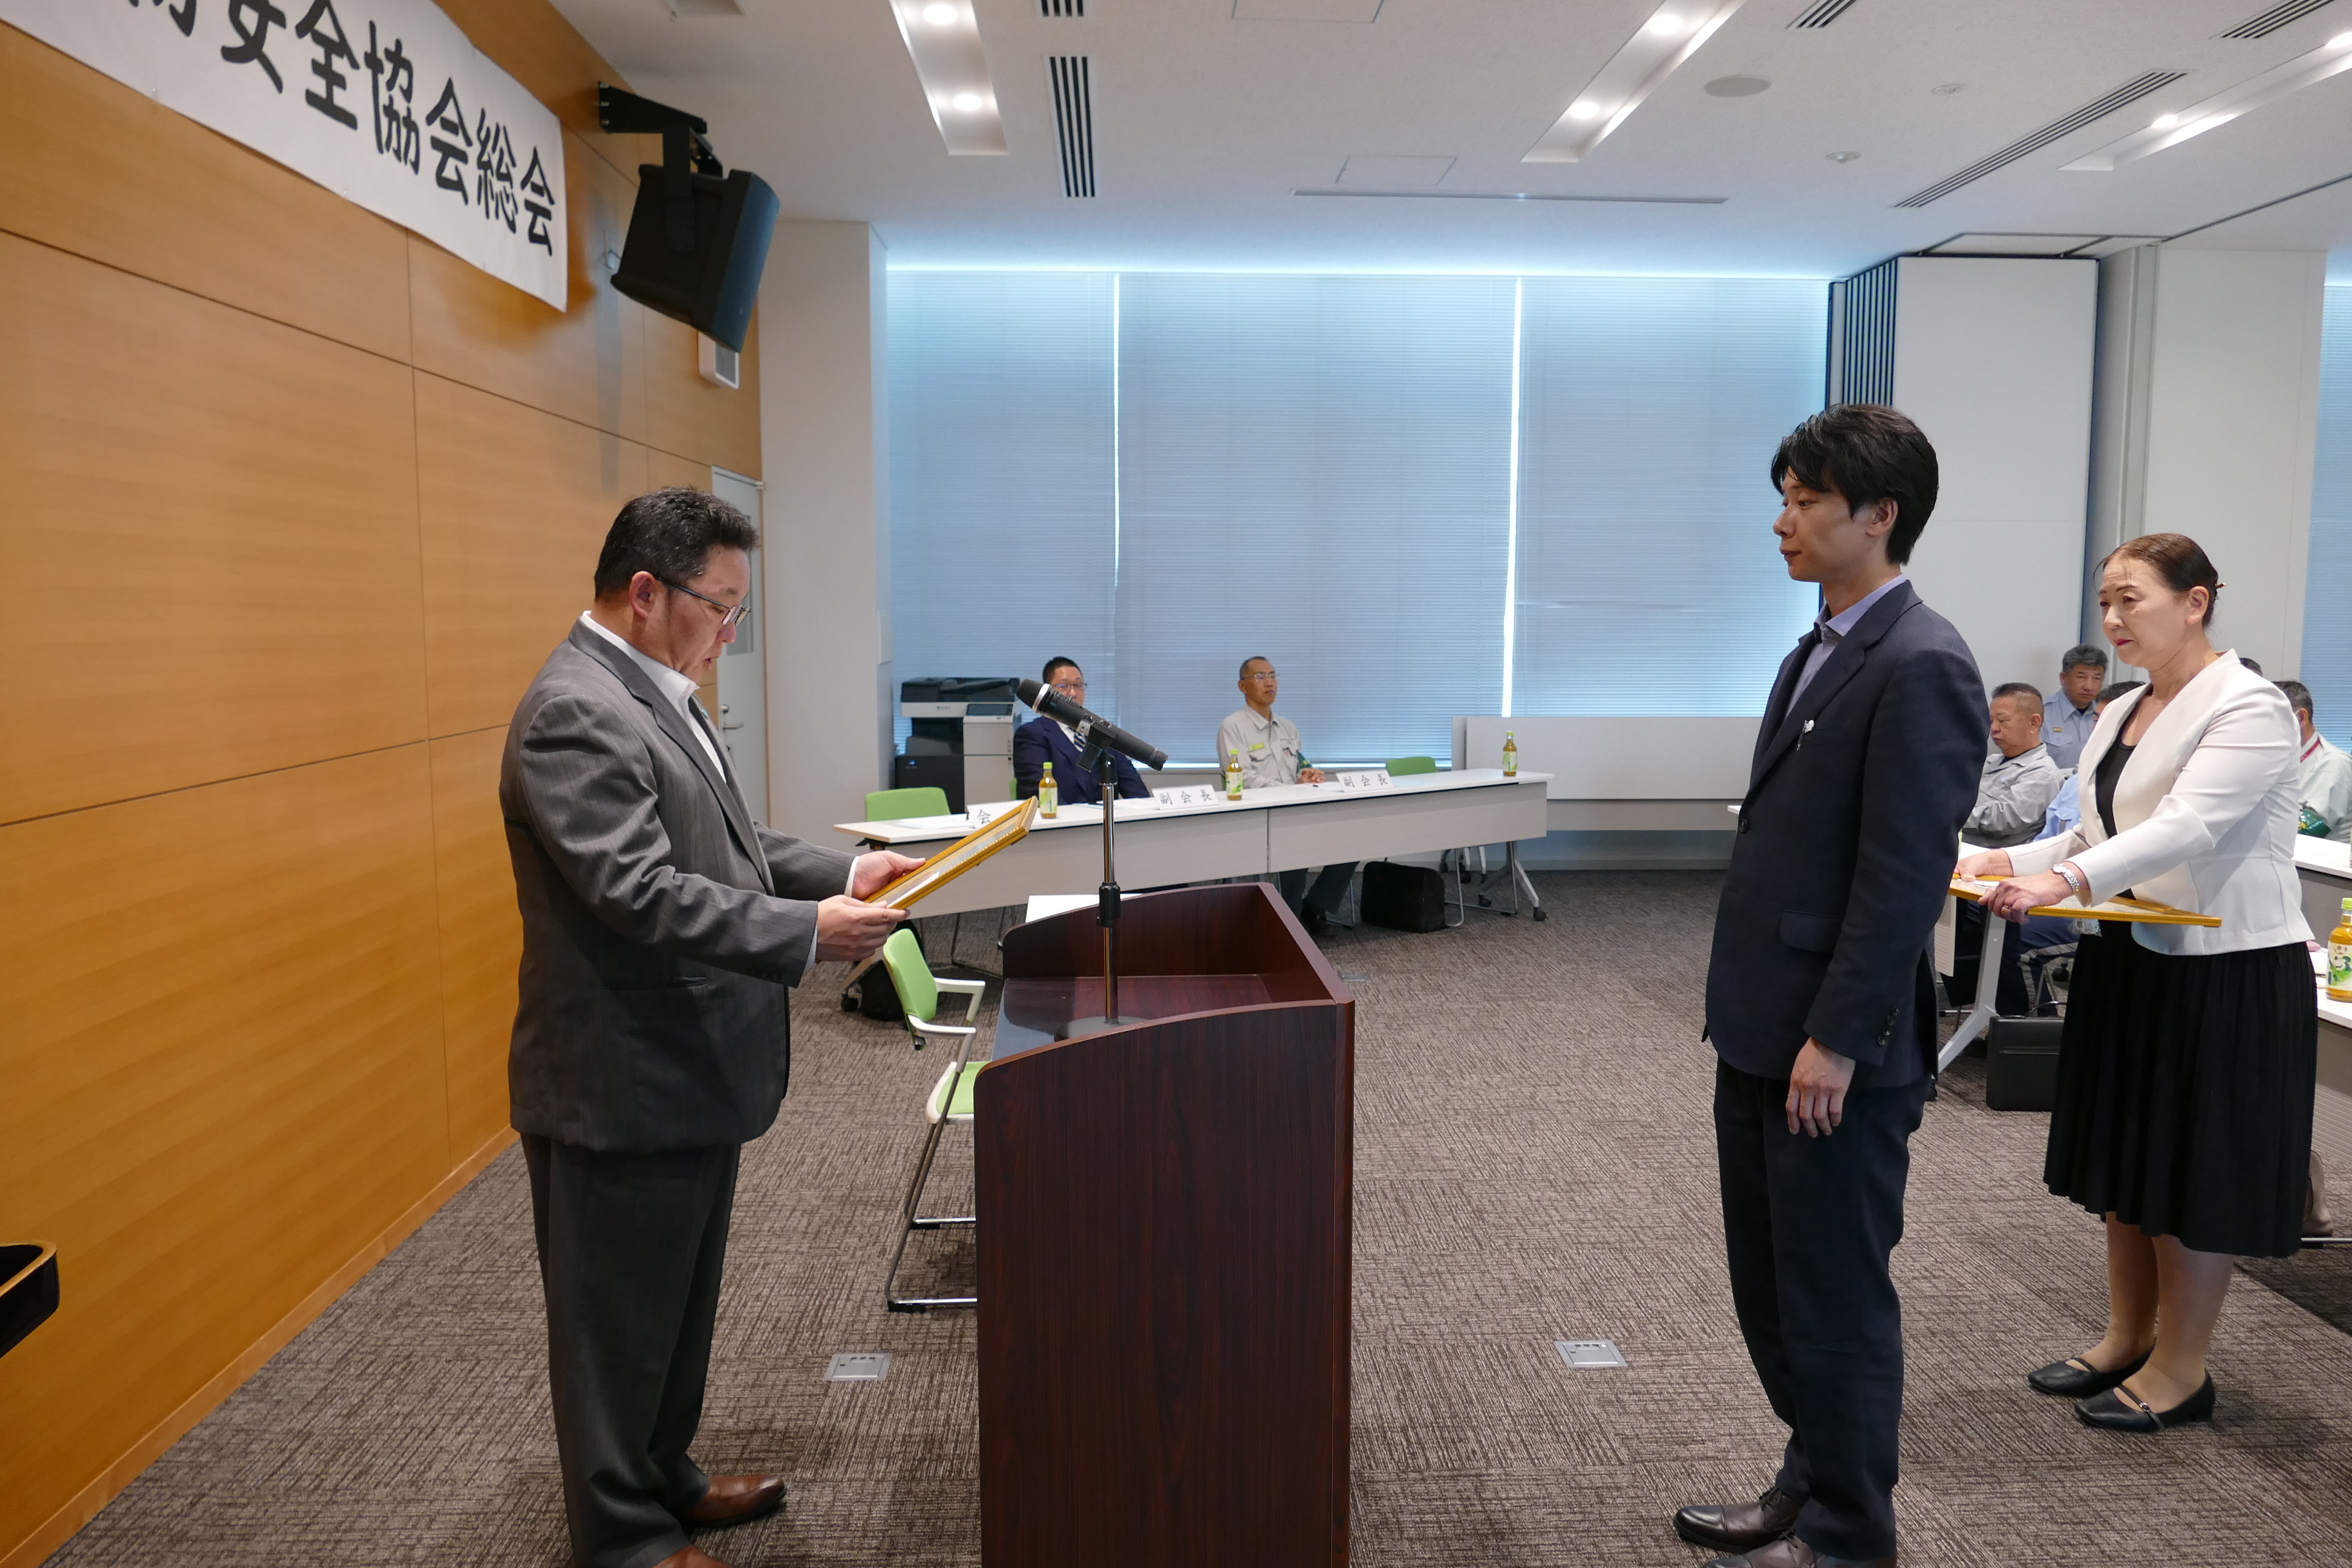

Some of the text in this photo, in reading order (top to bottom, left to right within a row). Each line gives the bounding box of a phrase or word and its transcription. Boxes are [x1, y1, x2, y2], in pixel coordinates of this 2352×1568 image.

[128, 0, 555, 257] 安全協会総会
[1342, 773, 1389, 788] 副会長
[1159, 789, 1213, 805] 副会長
